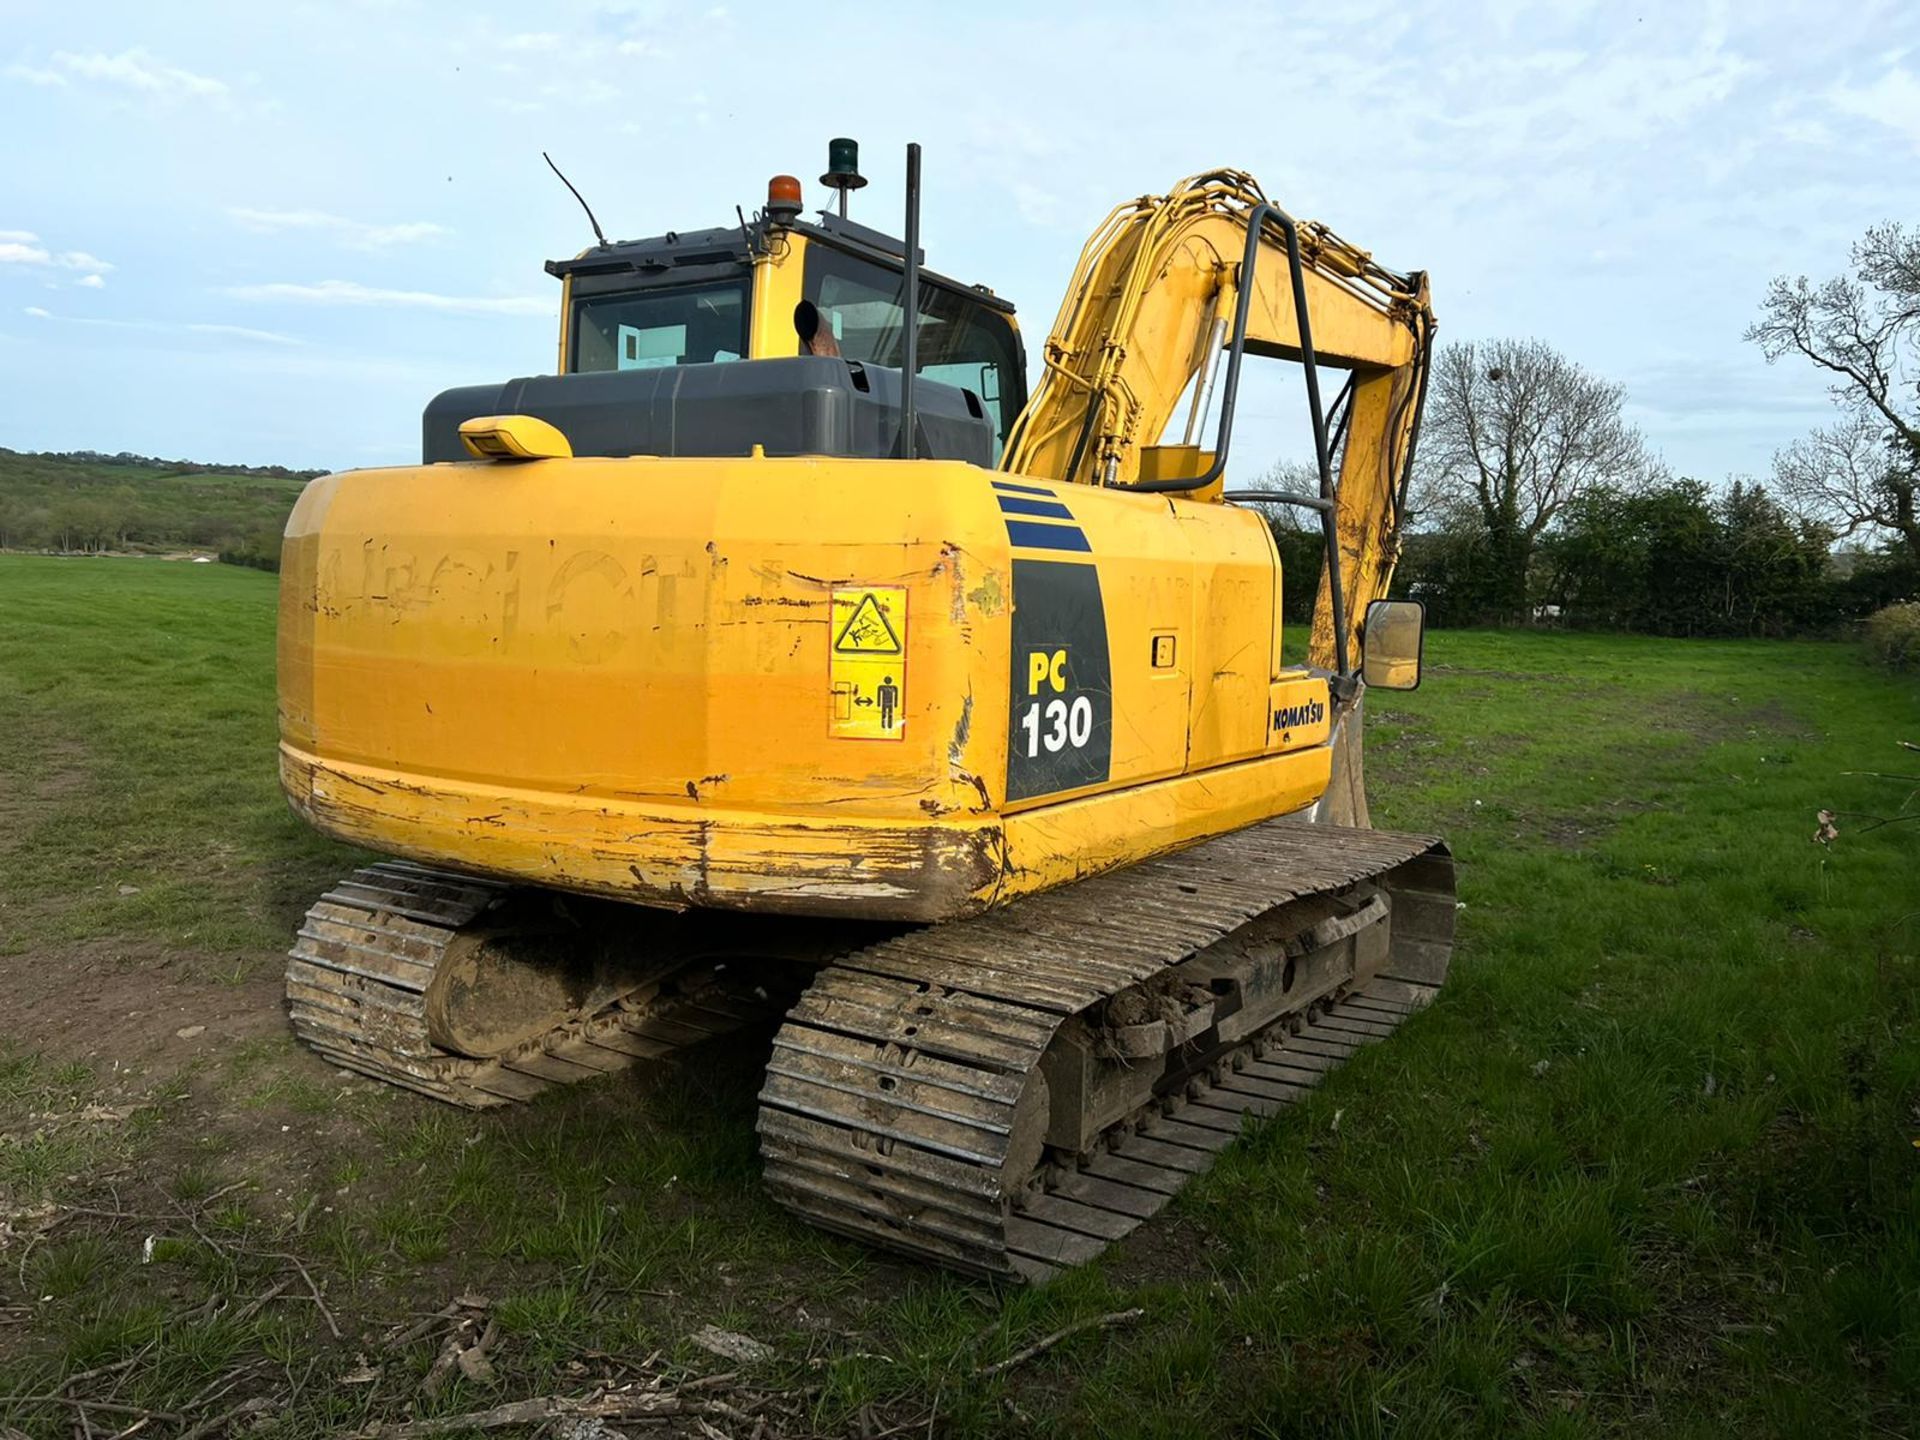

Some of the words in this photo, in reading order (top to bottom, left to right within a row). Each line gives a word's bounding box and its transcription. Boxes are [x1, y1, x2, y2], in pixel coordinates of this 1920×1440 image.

[1028, 649, 1067, 696] PC
[1022, 695, 1093, 758] 130
[1273, 698, 1324, 731] KOMATSU
